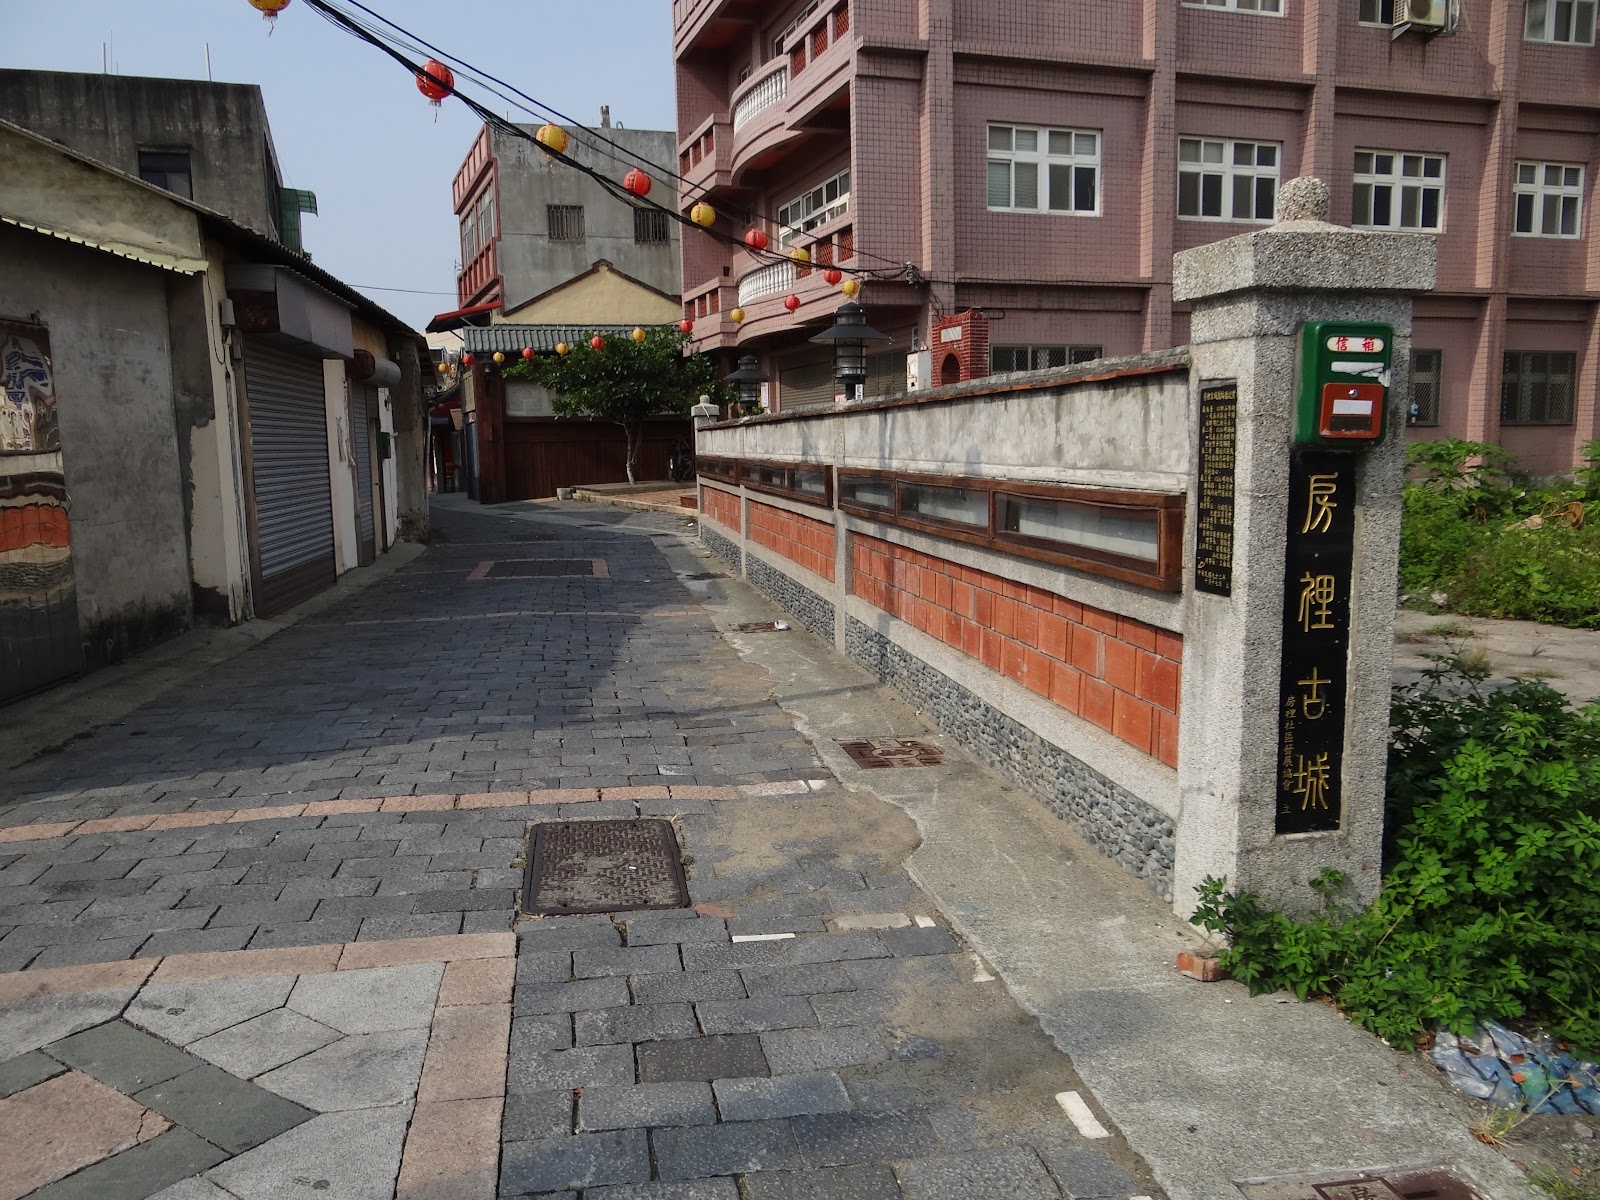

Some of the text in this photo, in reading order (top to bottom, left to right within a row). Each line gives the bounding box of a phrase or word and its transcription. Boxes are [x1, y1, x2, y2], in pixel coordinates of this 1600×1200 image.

[1336, 337, 1375, 352] 信箱
[1293, 471, 1339, 812] 房裡古城
[1281, 695, 1297, 792] 房裡社區發展協會
